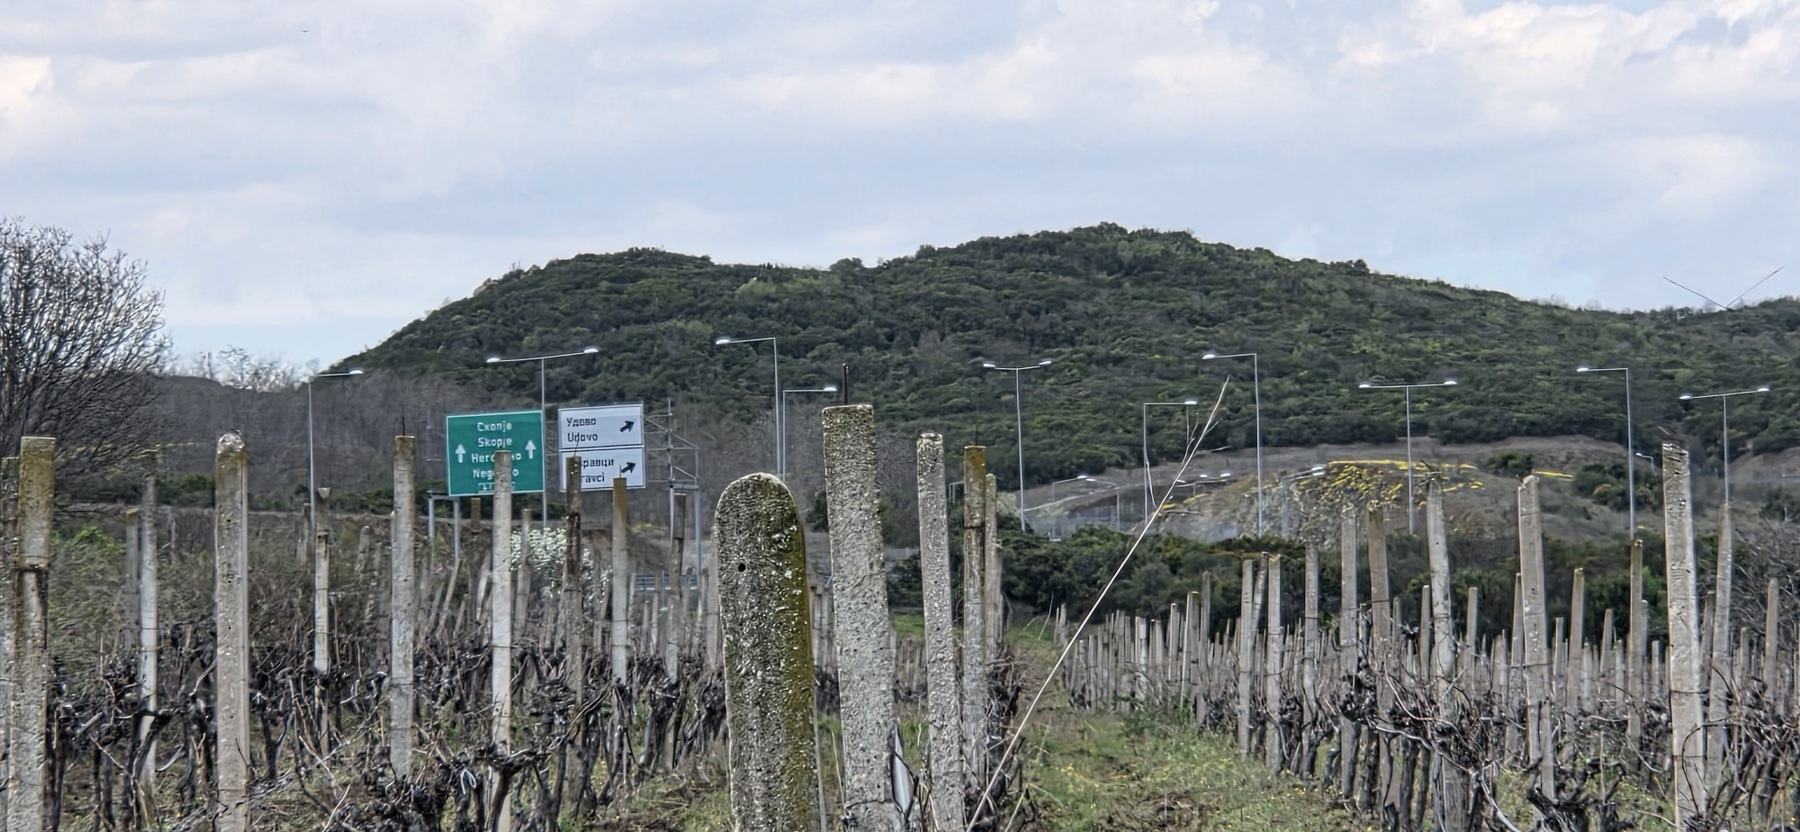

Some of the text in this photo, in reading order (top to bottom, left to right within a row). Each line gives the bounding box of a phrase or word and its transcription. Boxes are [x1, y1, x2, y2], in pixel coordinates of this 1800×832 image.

[477, 420, 512, 433] Скопје
[566, 417, 597, 427] Удово
[478, 437, 512, 449] Skopje
[567, 432, 598, 443] Udovo
[582, 458, 614, 469] равци
[473, 468, 519, 480] Nego
